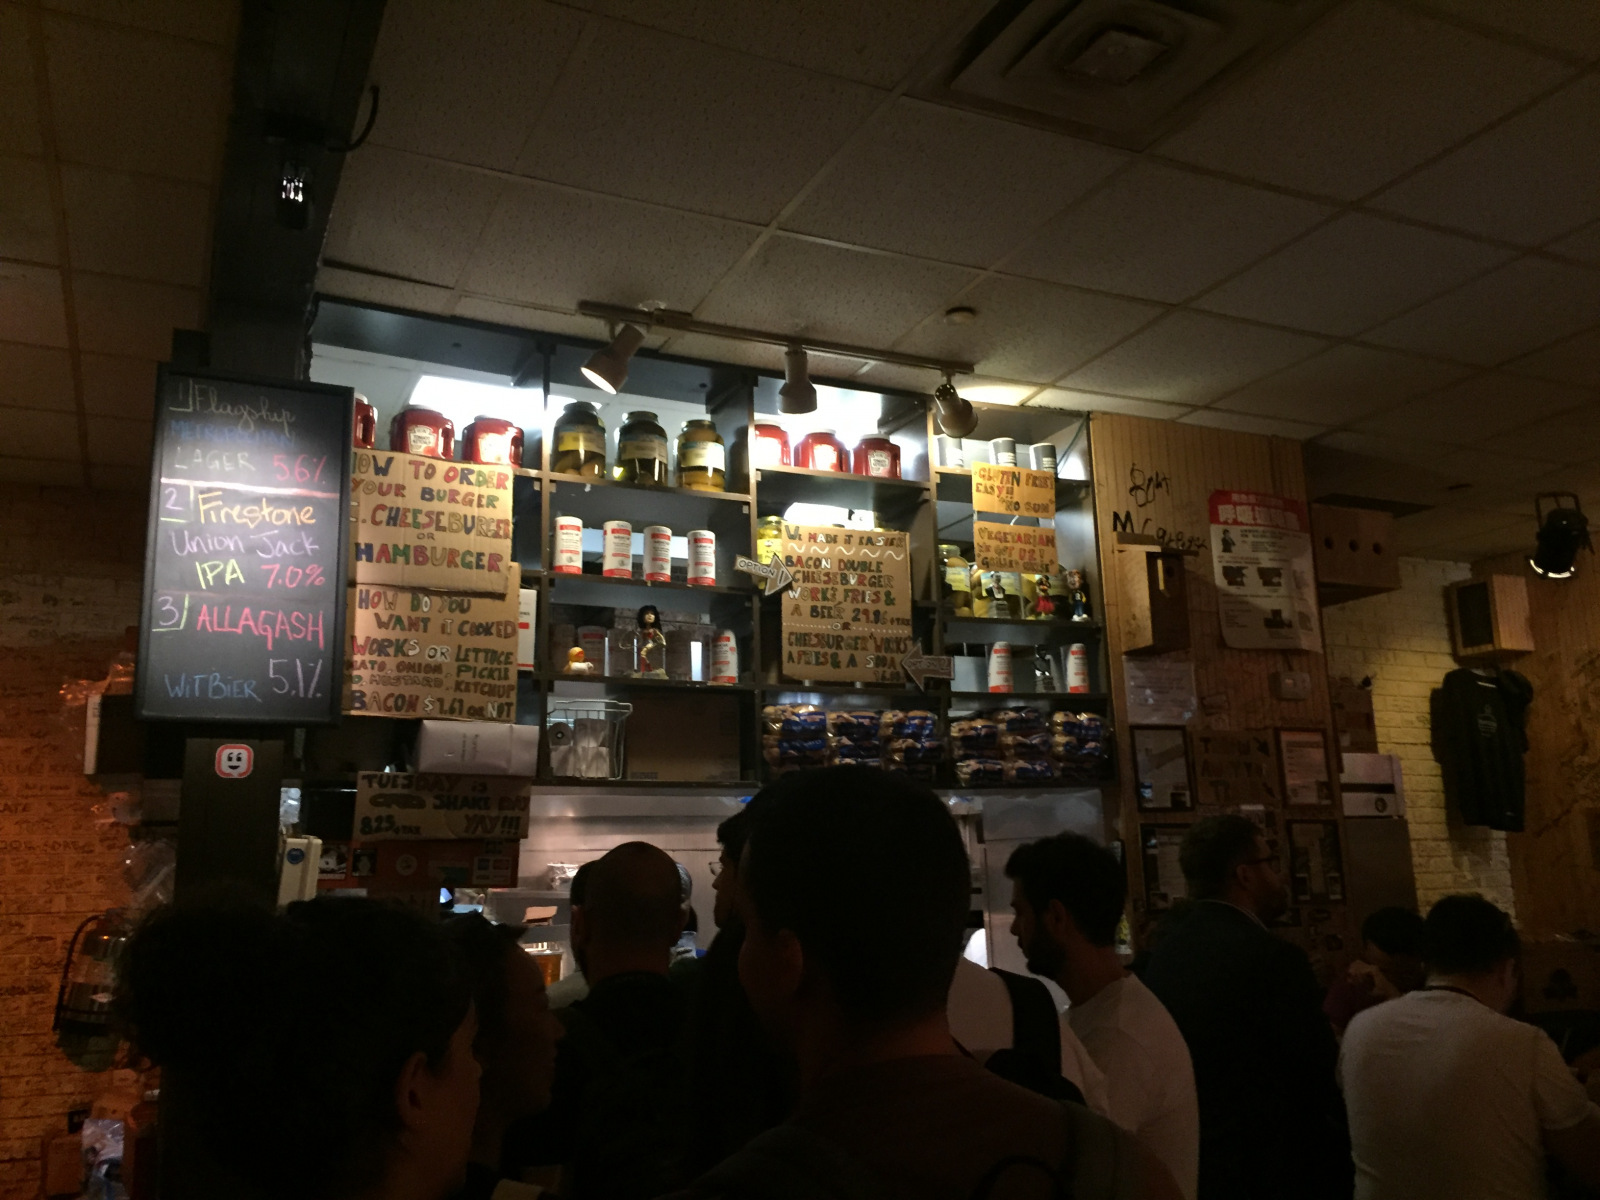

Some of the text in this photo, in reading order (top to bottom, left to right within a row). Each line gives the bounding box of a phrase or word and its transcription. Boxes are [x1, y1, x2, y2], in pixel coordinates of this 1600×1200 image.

[409, 459, 437, 480] TO
[443, 466, 510, 490] ORDER
[352, 477, 500, 509] YOUR BURGER
[198, 489, 316, 529] Firestone
[371, 503, 511, 539] CHEESEBURGER
[170, 529, 319, 559] Union Jack
[416, 532, 435, 541] OR
[808, 532, 839, 544] MADE
[858, 536, 905, 548] EASIER
[354, 542, 503, 573] HAMBURGER
[738, 559, 776, 577] OPTION
[785, 555, 884, 573] BACON DOUBLE
[195, 558, 326, 590] IPA 7.0%
[792, 569, 895, 589] CHEESEBURGER
[358, 589, 471, 614] HOW DO YOU
[843, 588, 881, 604] FRIES
[883, 590, 896, 606] &
[791, 603, 802, 617] A
[196, 603, 325, 650] ALLAGASH
[374, 612, 431, 633] WANT
[457, 620, 518, 639] COOKED
[832, 621, 851, 631] OR
[352, 635, 514, 666] WORKS OR LETTUCE
[846, 653, 858, 668] A
[865, 654, 897, 671] SODA
[269, 658, 323, 699] 5.1%
[457, 664, 510, 681] PICKLE
[454, 679, 515, 698] KETCHUP
[351, 689, 420, 713] BACON
[487, 701, 514, 719] NOT
[432, 794, 490, 810] SHAKE
